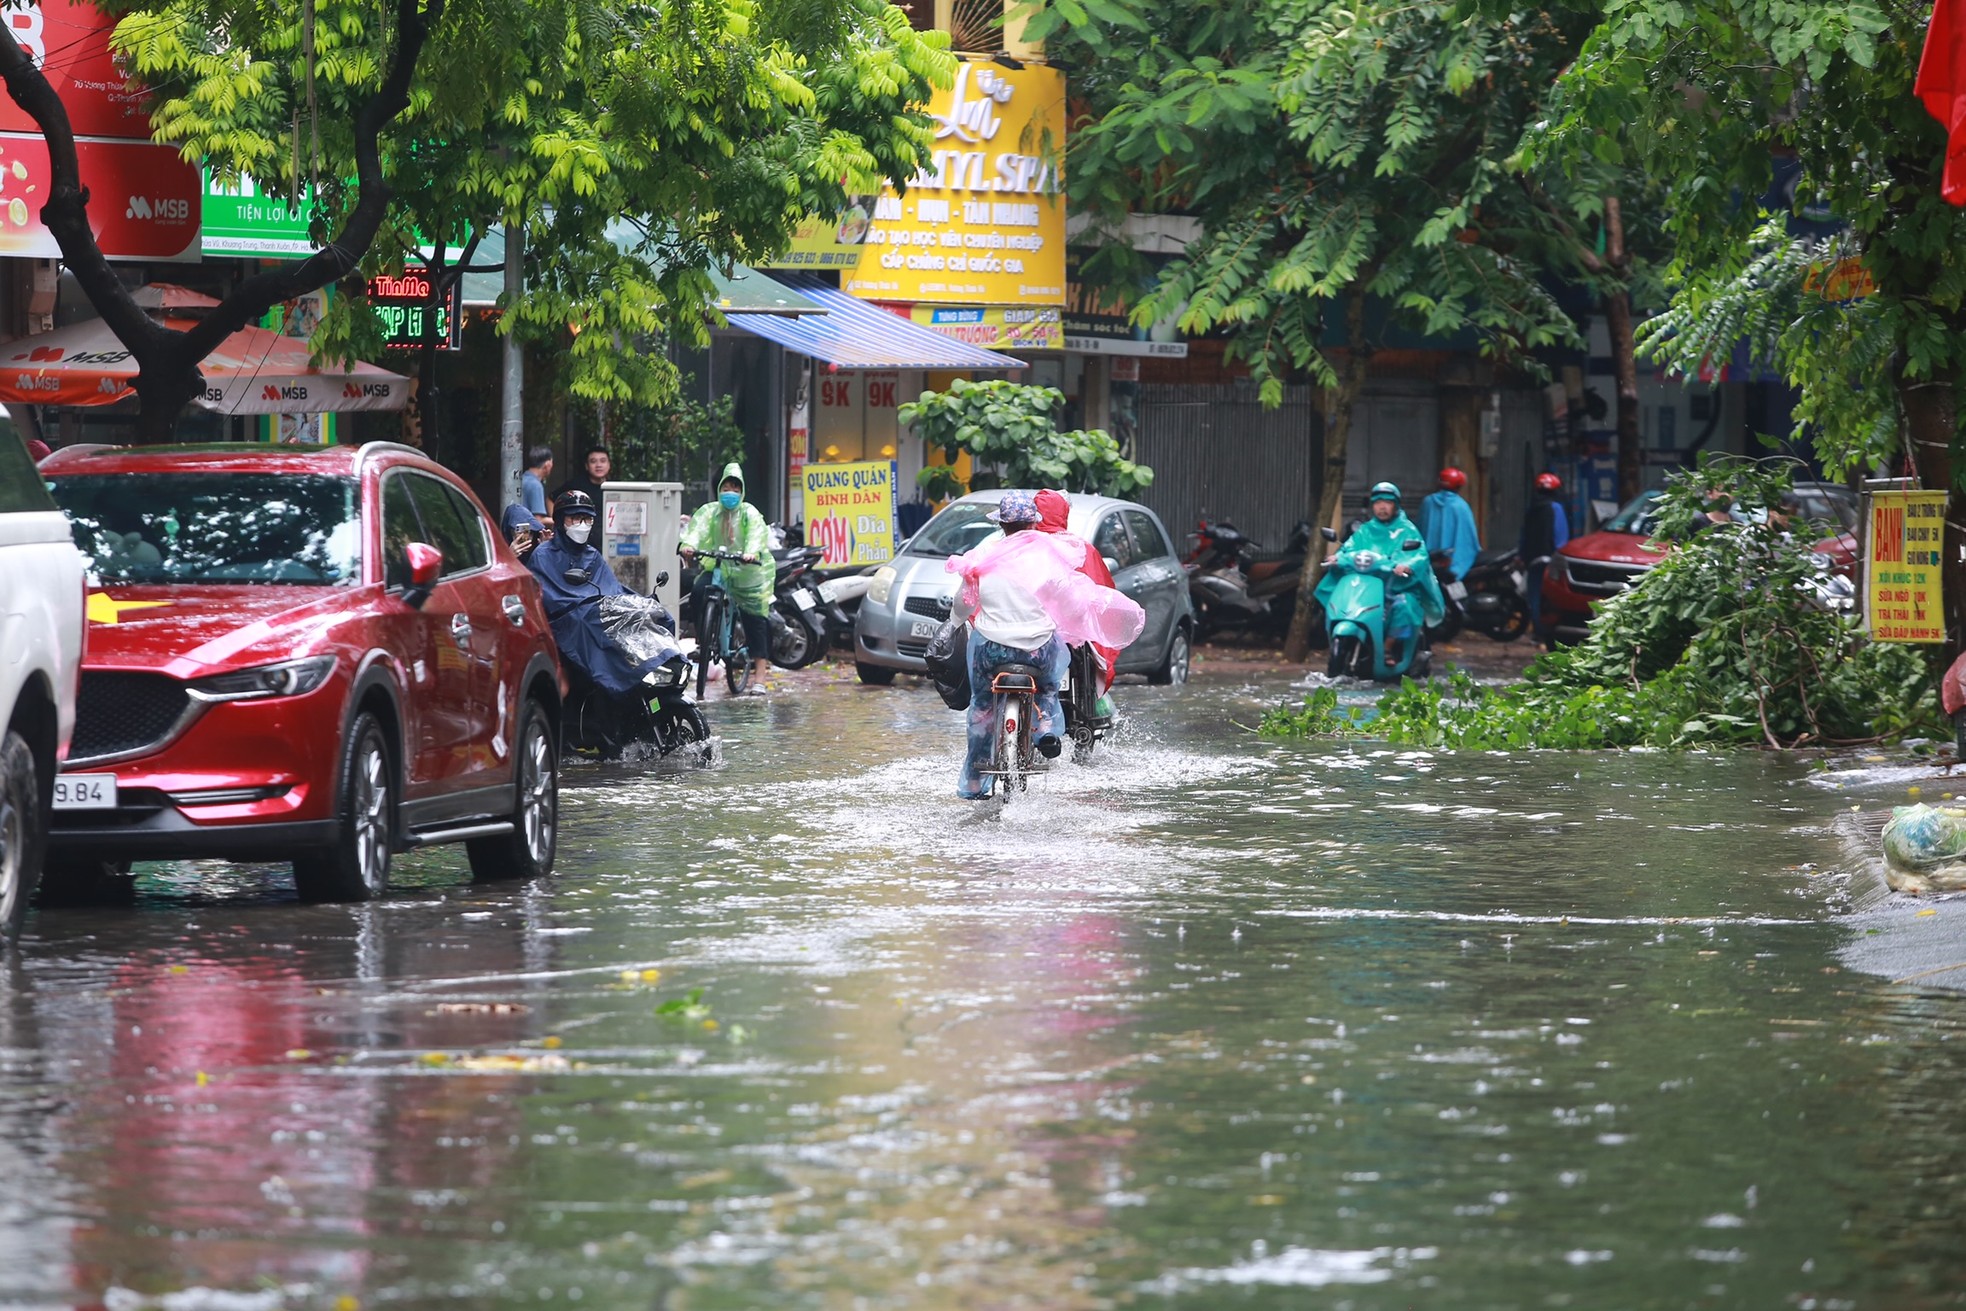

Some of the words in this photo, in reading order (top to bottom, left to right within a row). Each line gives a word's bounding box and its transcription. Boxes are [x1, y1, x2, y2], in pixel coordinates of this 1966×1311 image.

[154, 198, 189, 219] MSB
[237, 205, 262, 224] TIỆN
[266, 207, 285, 226] LỢI
[1004, 259, 1024, 274] GIA
[62, 351, 130, 364] MSB
[34, 377, 61, 391] MSB
[363, 384, 390, 397] MSB
[281, 387, 308, 400] MSB
[869, 381, 896, 408] 9K
[807, 471, 850, 492] QUANG
[852, 465, 887, 490] QUÁN
[816, 490, 849, 506] BÌNH
[853, 489, 882, 505] DÂN
